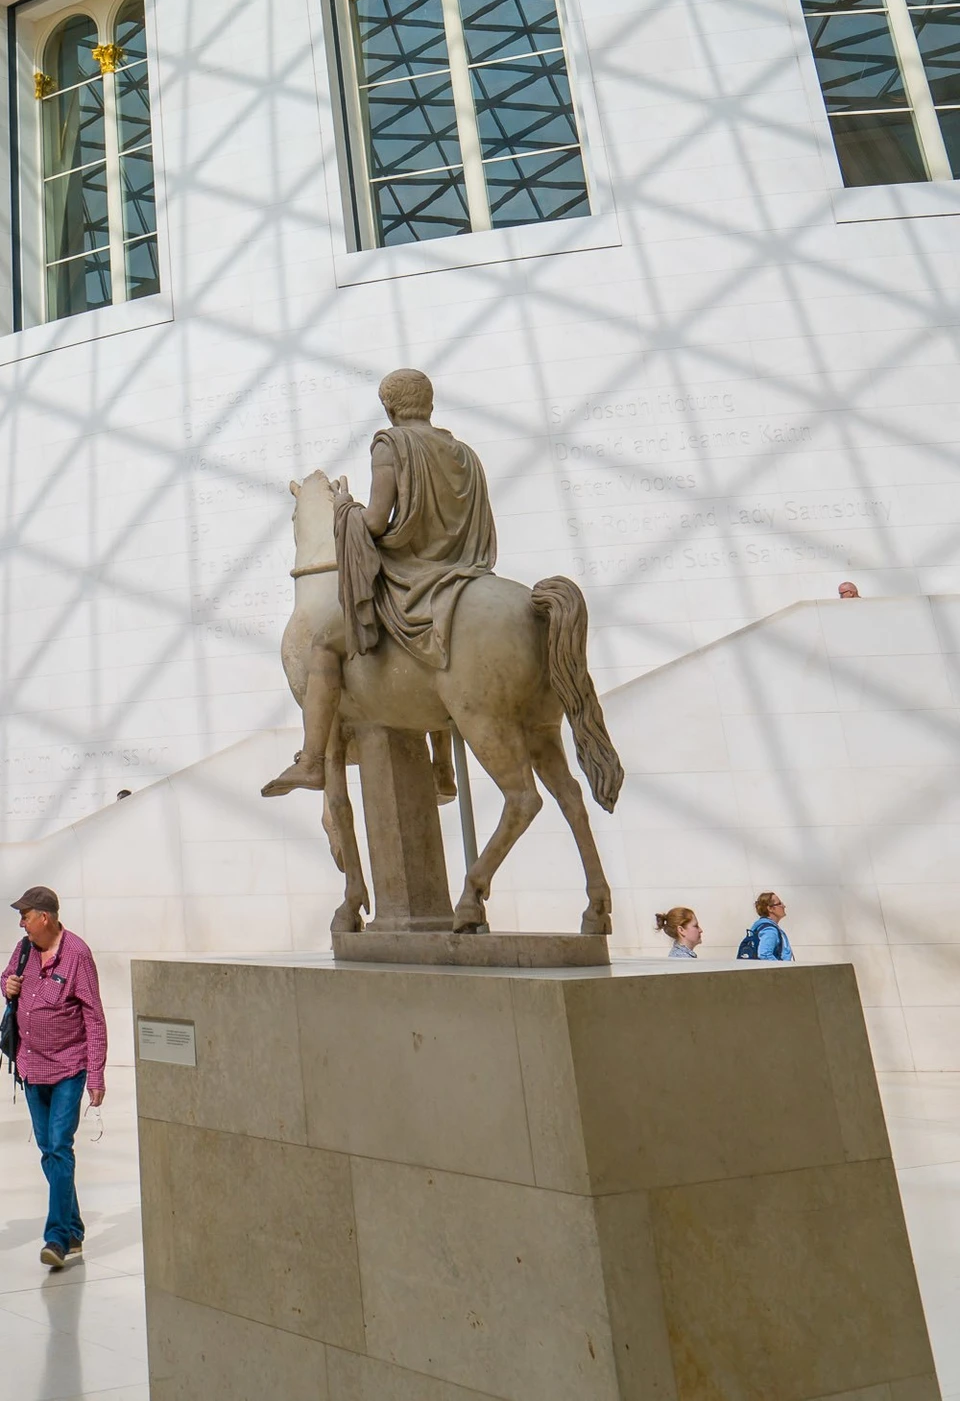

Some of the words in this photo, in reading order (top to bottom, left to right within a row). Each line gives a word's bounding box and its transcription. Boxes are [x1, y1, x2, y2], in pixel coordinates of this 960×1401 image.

[551, 404, 576, 424] Sir
[583, 396, 649, 422] Joseph
[657, 393, 736, 415] Hotung
[555, 436, 624, 461] Donald
[634, 432, 670, 454] and
[679, 428, 751, 451] Jeanne
[560, 478, 612, 498] Peter
[619, 473, 697, 493] Moores
[566, 517, 594, 538] Sir
[680, 506, 719, 529] and
[726, 502, 776, 529] Lady
[784, 497, 893, 522] Sainsbury
[573, 552, 629, 577] David
[638, 550, 675, 572] and
[682, 547, 740, 570] Susie
[745, 541, 853, 566] Sainsbury
